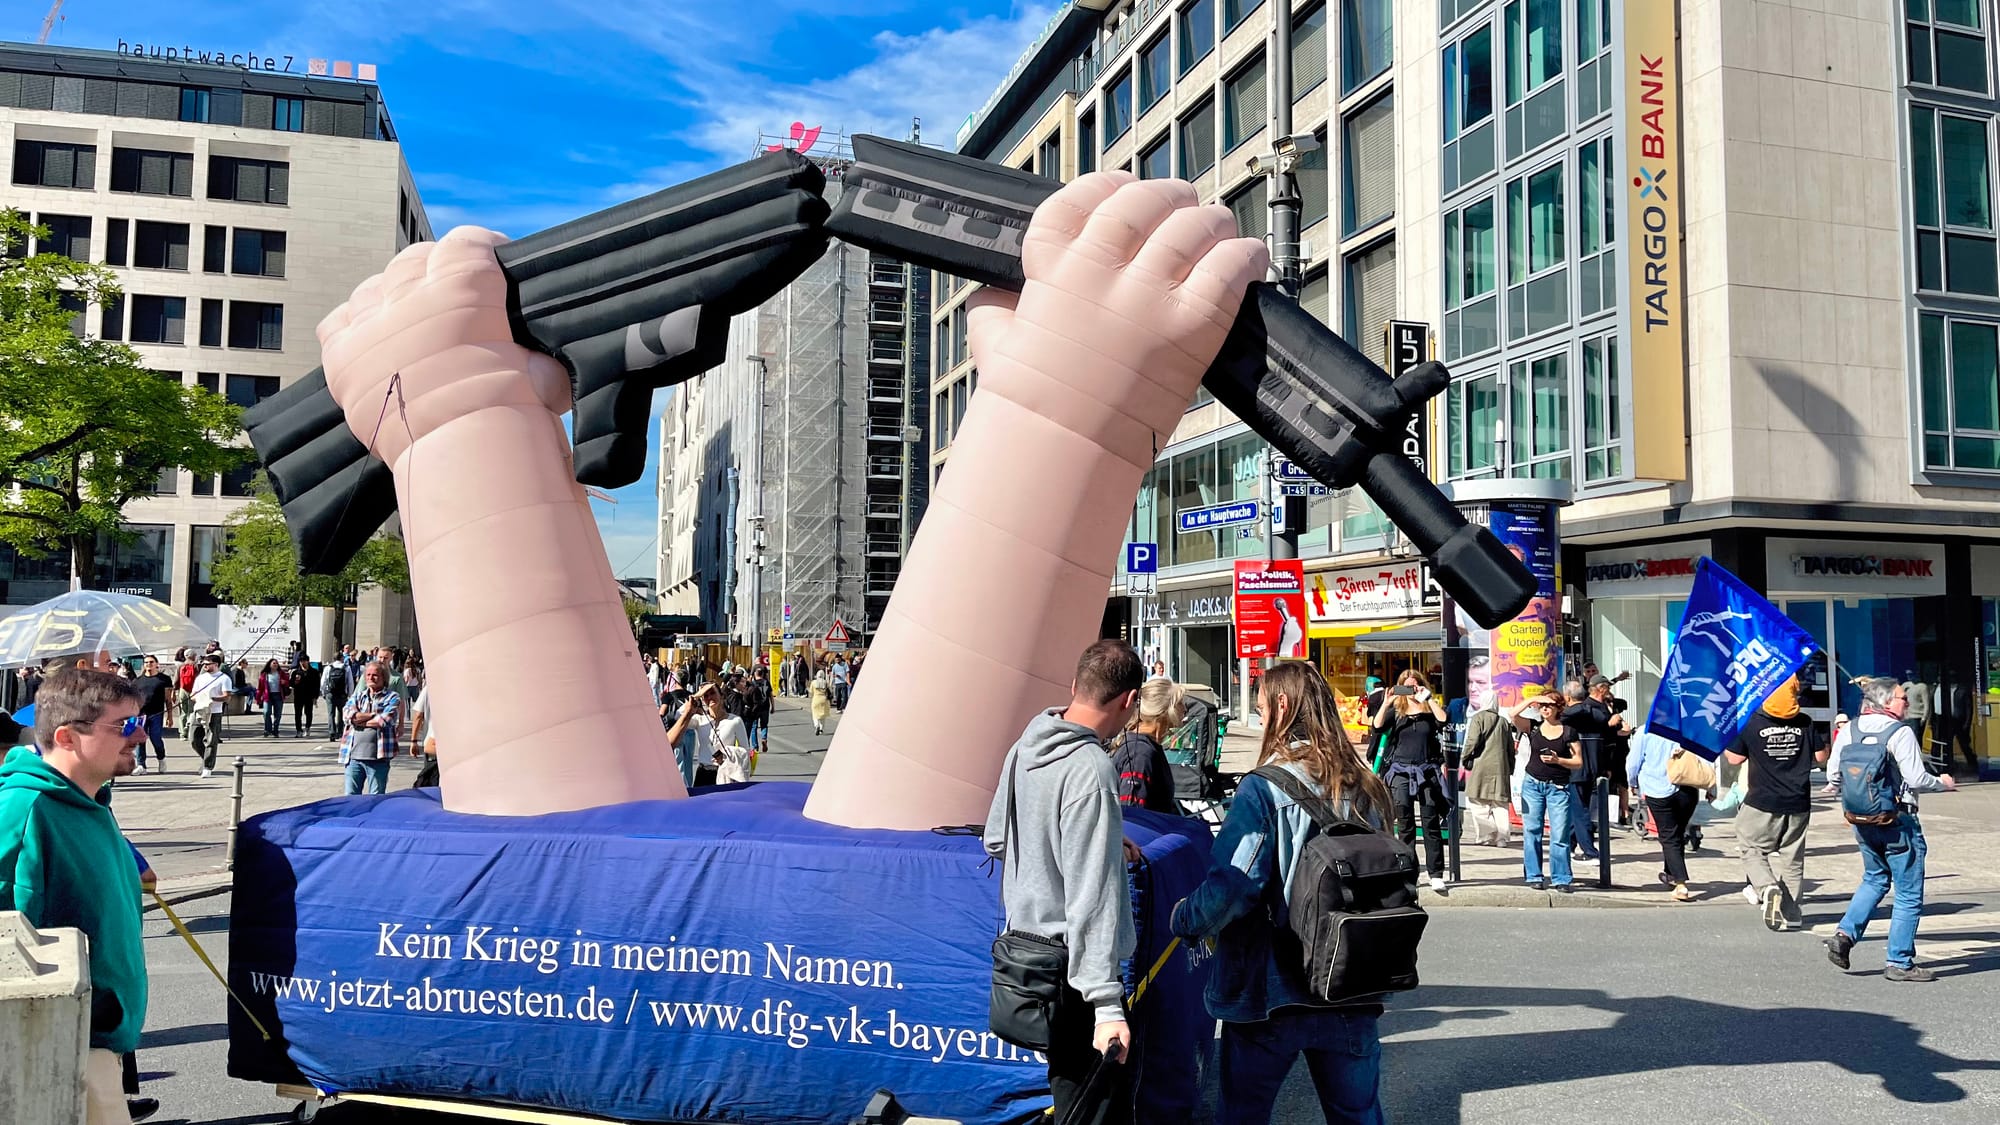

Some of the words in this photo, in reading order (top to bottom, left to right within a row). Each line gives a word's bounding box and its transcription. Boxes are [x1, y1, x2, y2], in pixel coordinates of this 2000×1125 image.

[1235, 451, 1262, 481] JAC
[1186, 513, 1195, 526] An
[1197, 510, 1208, 524] der
[1210, 505, 1252, 523] Hauptwache
[1134, 546, 1150, 570] P
[1239, 571, 1260, 581] Pop,
[1261, 571, 1295, 580] Politik,
[1335, 567, 1419, 600] Bären-Treff
[107, 587, 153, 596] WEMPE
[1239, 580, 1299, 589] Faschismus?
[1340, 602, 1352, 612] Der
[1510, 624, 1543, 635] Garten
[1508, 637, 1546, 648] Utopien
[375, 922, 453, 960] Kein
[461, 926, 561, 974] Krieg
[570, 929, 602, 968] in
[611, 935, 752, 977] meinem
[762, 942, 904, 990] Namen.
[250, 969, 615, 1023] www.jetzt-abruesten.de
[624, 989, 639, 1025] /
